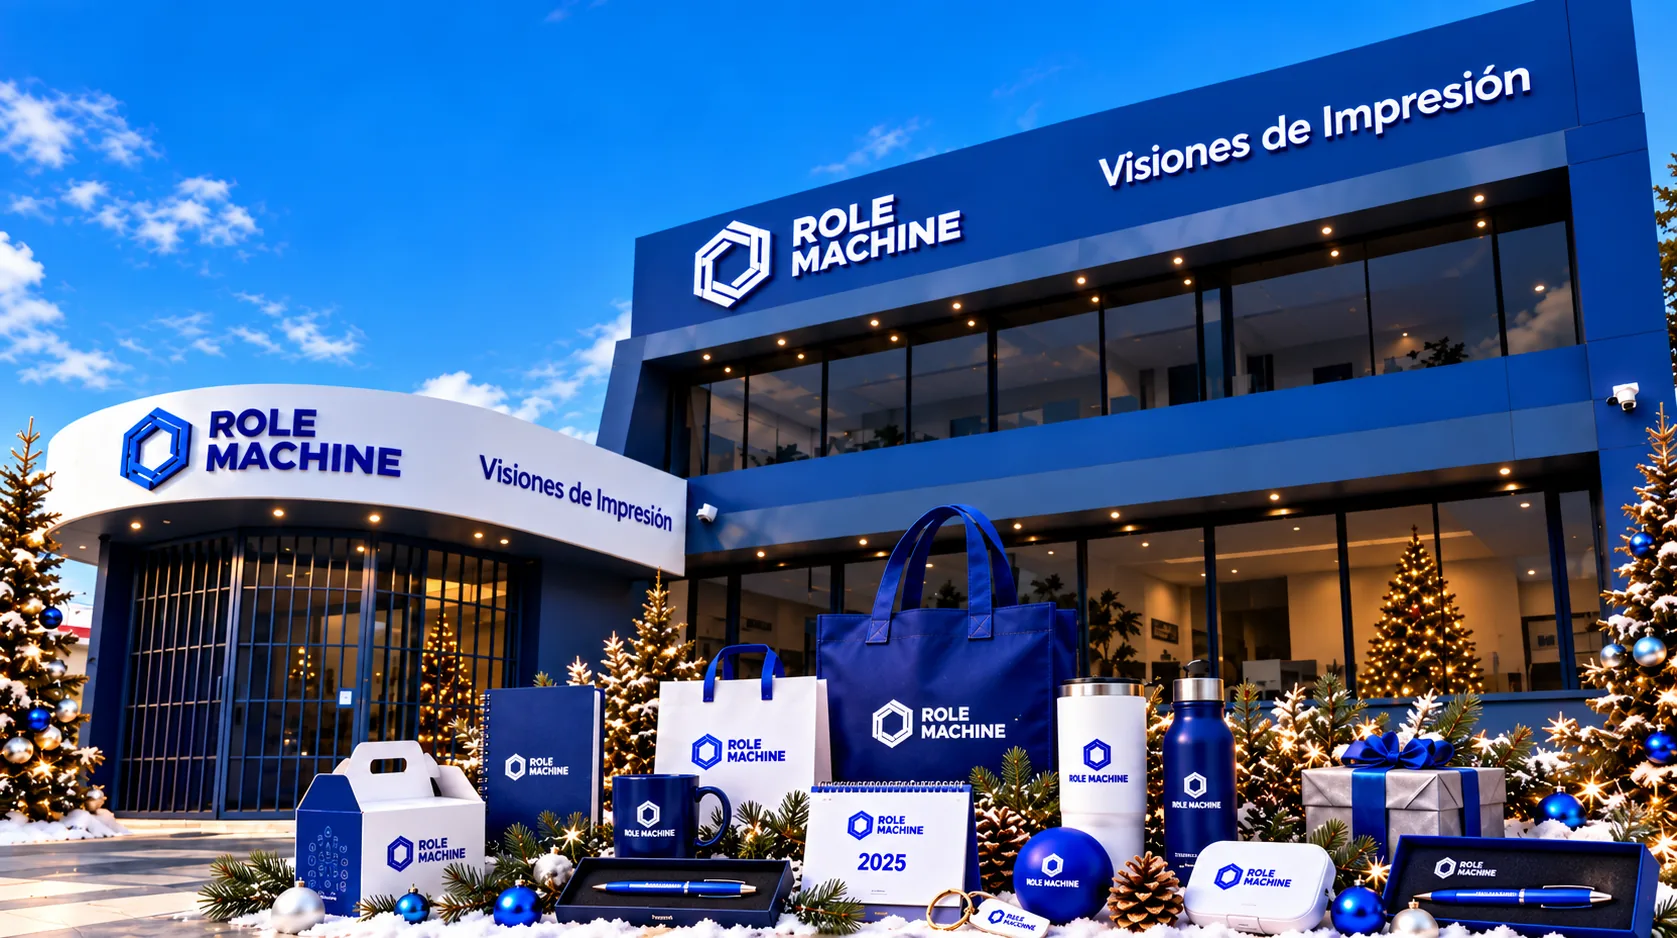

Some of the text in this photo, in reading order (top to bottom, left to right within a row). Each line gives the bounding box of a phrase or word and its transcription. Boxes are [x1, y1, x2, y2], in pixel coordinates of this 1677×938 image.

[1099, 65, 1530, 186] Visiones de Impresión
[793, 194, 895, 247] ROLE
[791, 210, 961, 277] MACHINE
[210, 409, 317, 438] ROLE
[206, 442, 401, 477] MACHINE
[480, 455, 672, 532] Visiones de Impresión
[922, 707, 969, 722] ROLE
[922, 724, 1005, 738] MACHINE
[727, 738, 762, 751] ROLE
[528, 756, 554, 767] ROLE
[726, 750, 787, 763] MACHINE
[528, 765, 570, 776] MACHINE
[1068, 774, 1129, 784] ROLE MACHINE
[1188, 801, 1222, 809] MACHINE
[877, 815, 906, 825] ROLE
[640, 828, 676, 838] MACHINE
[876, 825, 924, 835] MACHINE
[418, 837, 449, 851] ROLE
[418, 848, 466, 863] MACHINE
[858, 853, 906, 871] 2025
[1459, 860, 1484, 869] ROLE
[1246, 868, 1276, 878] ROLE
[1457, 868, 1497, 877] MACHINE
[1043, 879, 1080, 888] MACHINE
[1243, 877, 1292, 888] MACHINE
